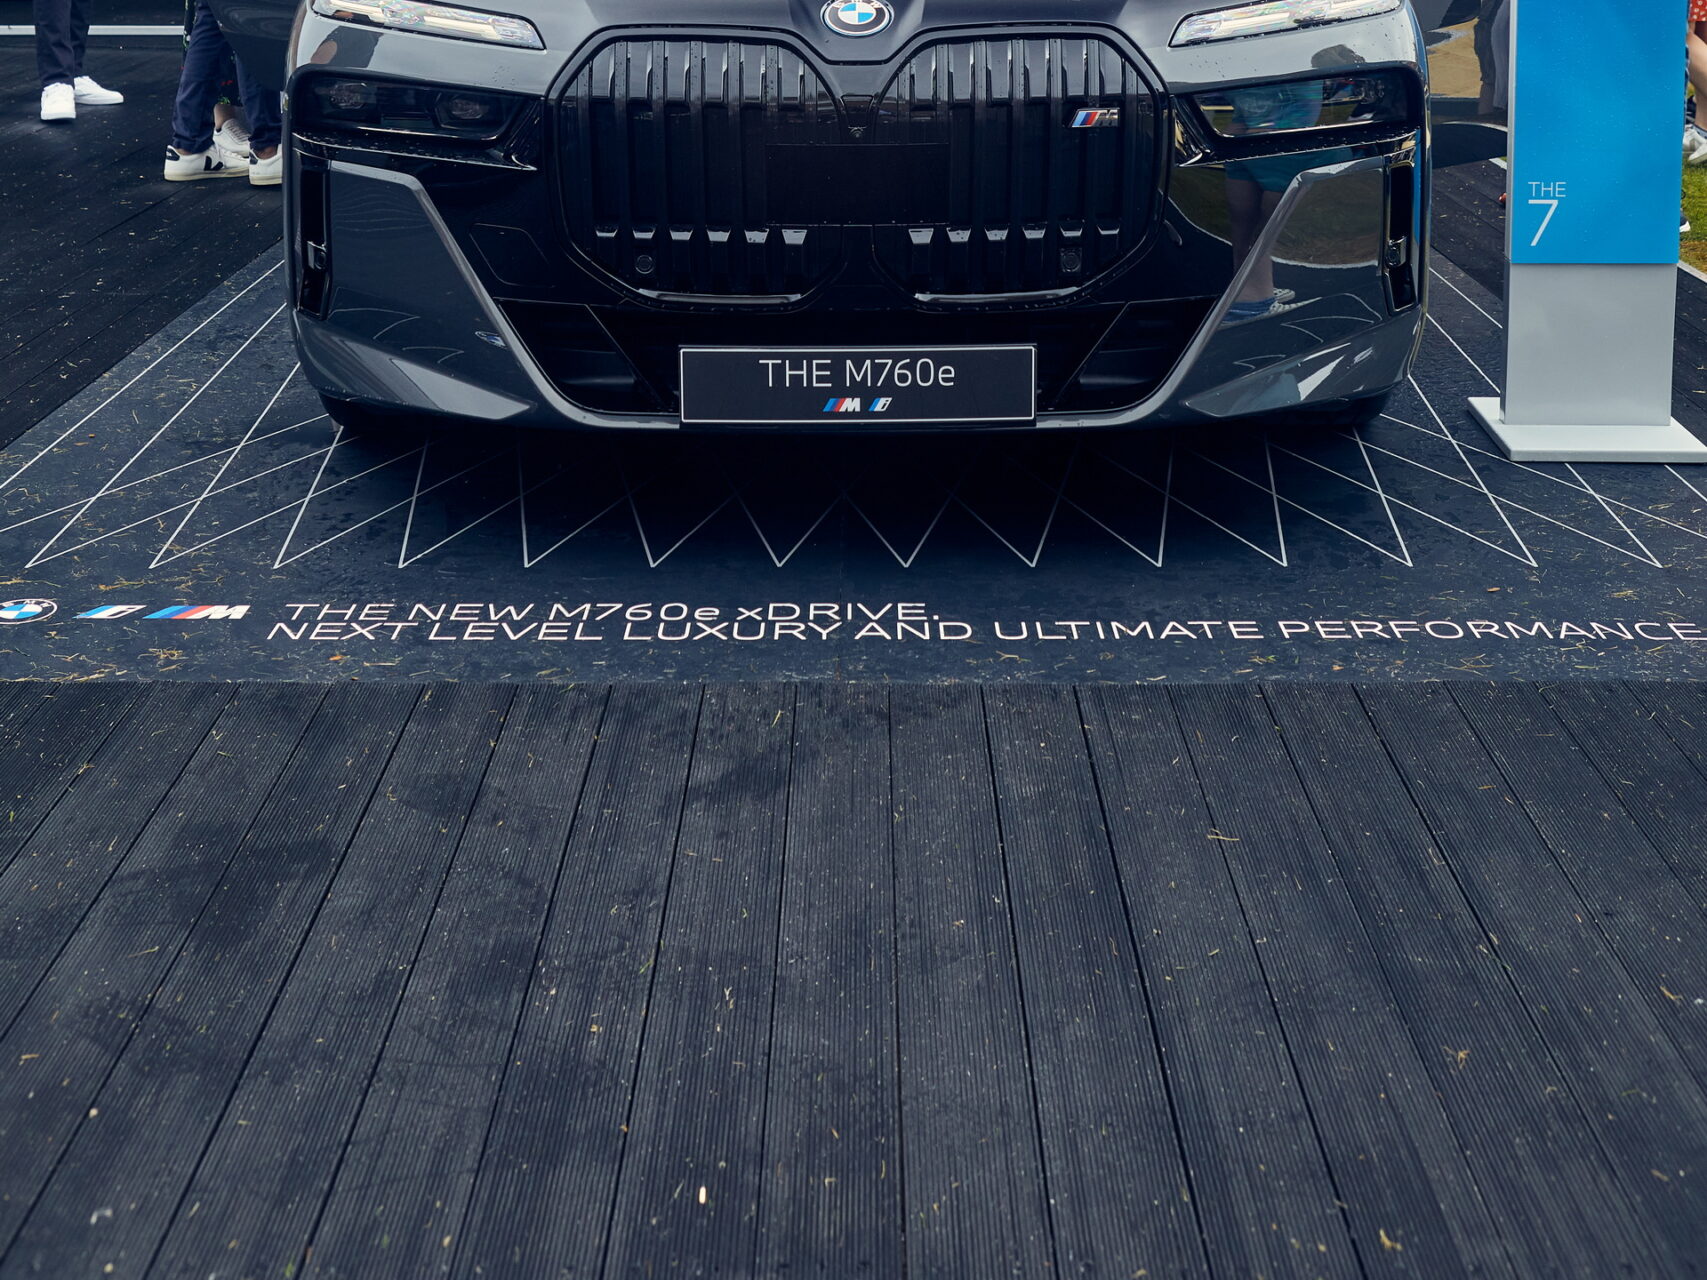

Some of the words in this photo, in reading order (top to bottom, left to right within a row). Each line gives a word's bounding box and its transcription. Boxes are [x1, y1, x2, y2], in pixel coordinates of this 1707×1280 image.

[1528, 181, 1567, 198] THE
[1528, 199, 1559, 247] 7
[759, 359, 832, 387] THE
[845, 358, 956, 387] M760e
[285, 603, 395, 620] THE
[408, 603, 535, 620] NEW
[549, 603, 720, 621] M760e
[736, 603, 939, 621] xDRIVE.
[266, 622, 419, 640] NEXT
[428, 622, 603, 640] LEVEL
[623, 622, 842, 640] LUXURY
[854, 622, 972, 640] AND
[994, 621, 1264, 639] ULTIMATE
[1278, 621, 1707, 640] PERFORMANCE
